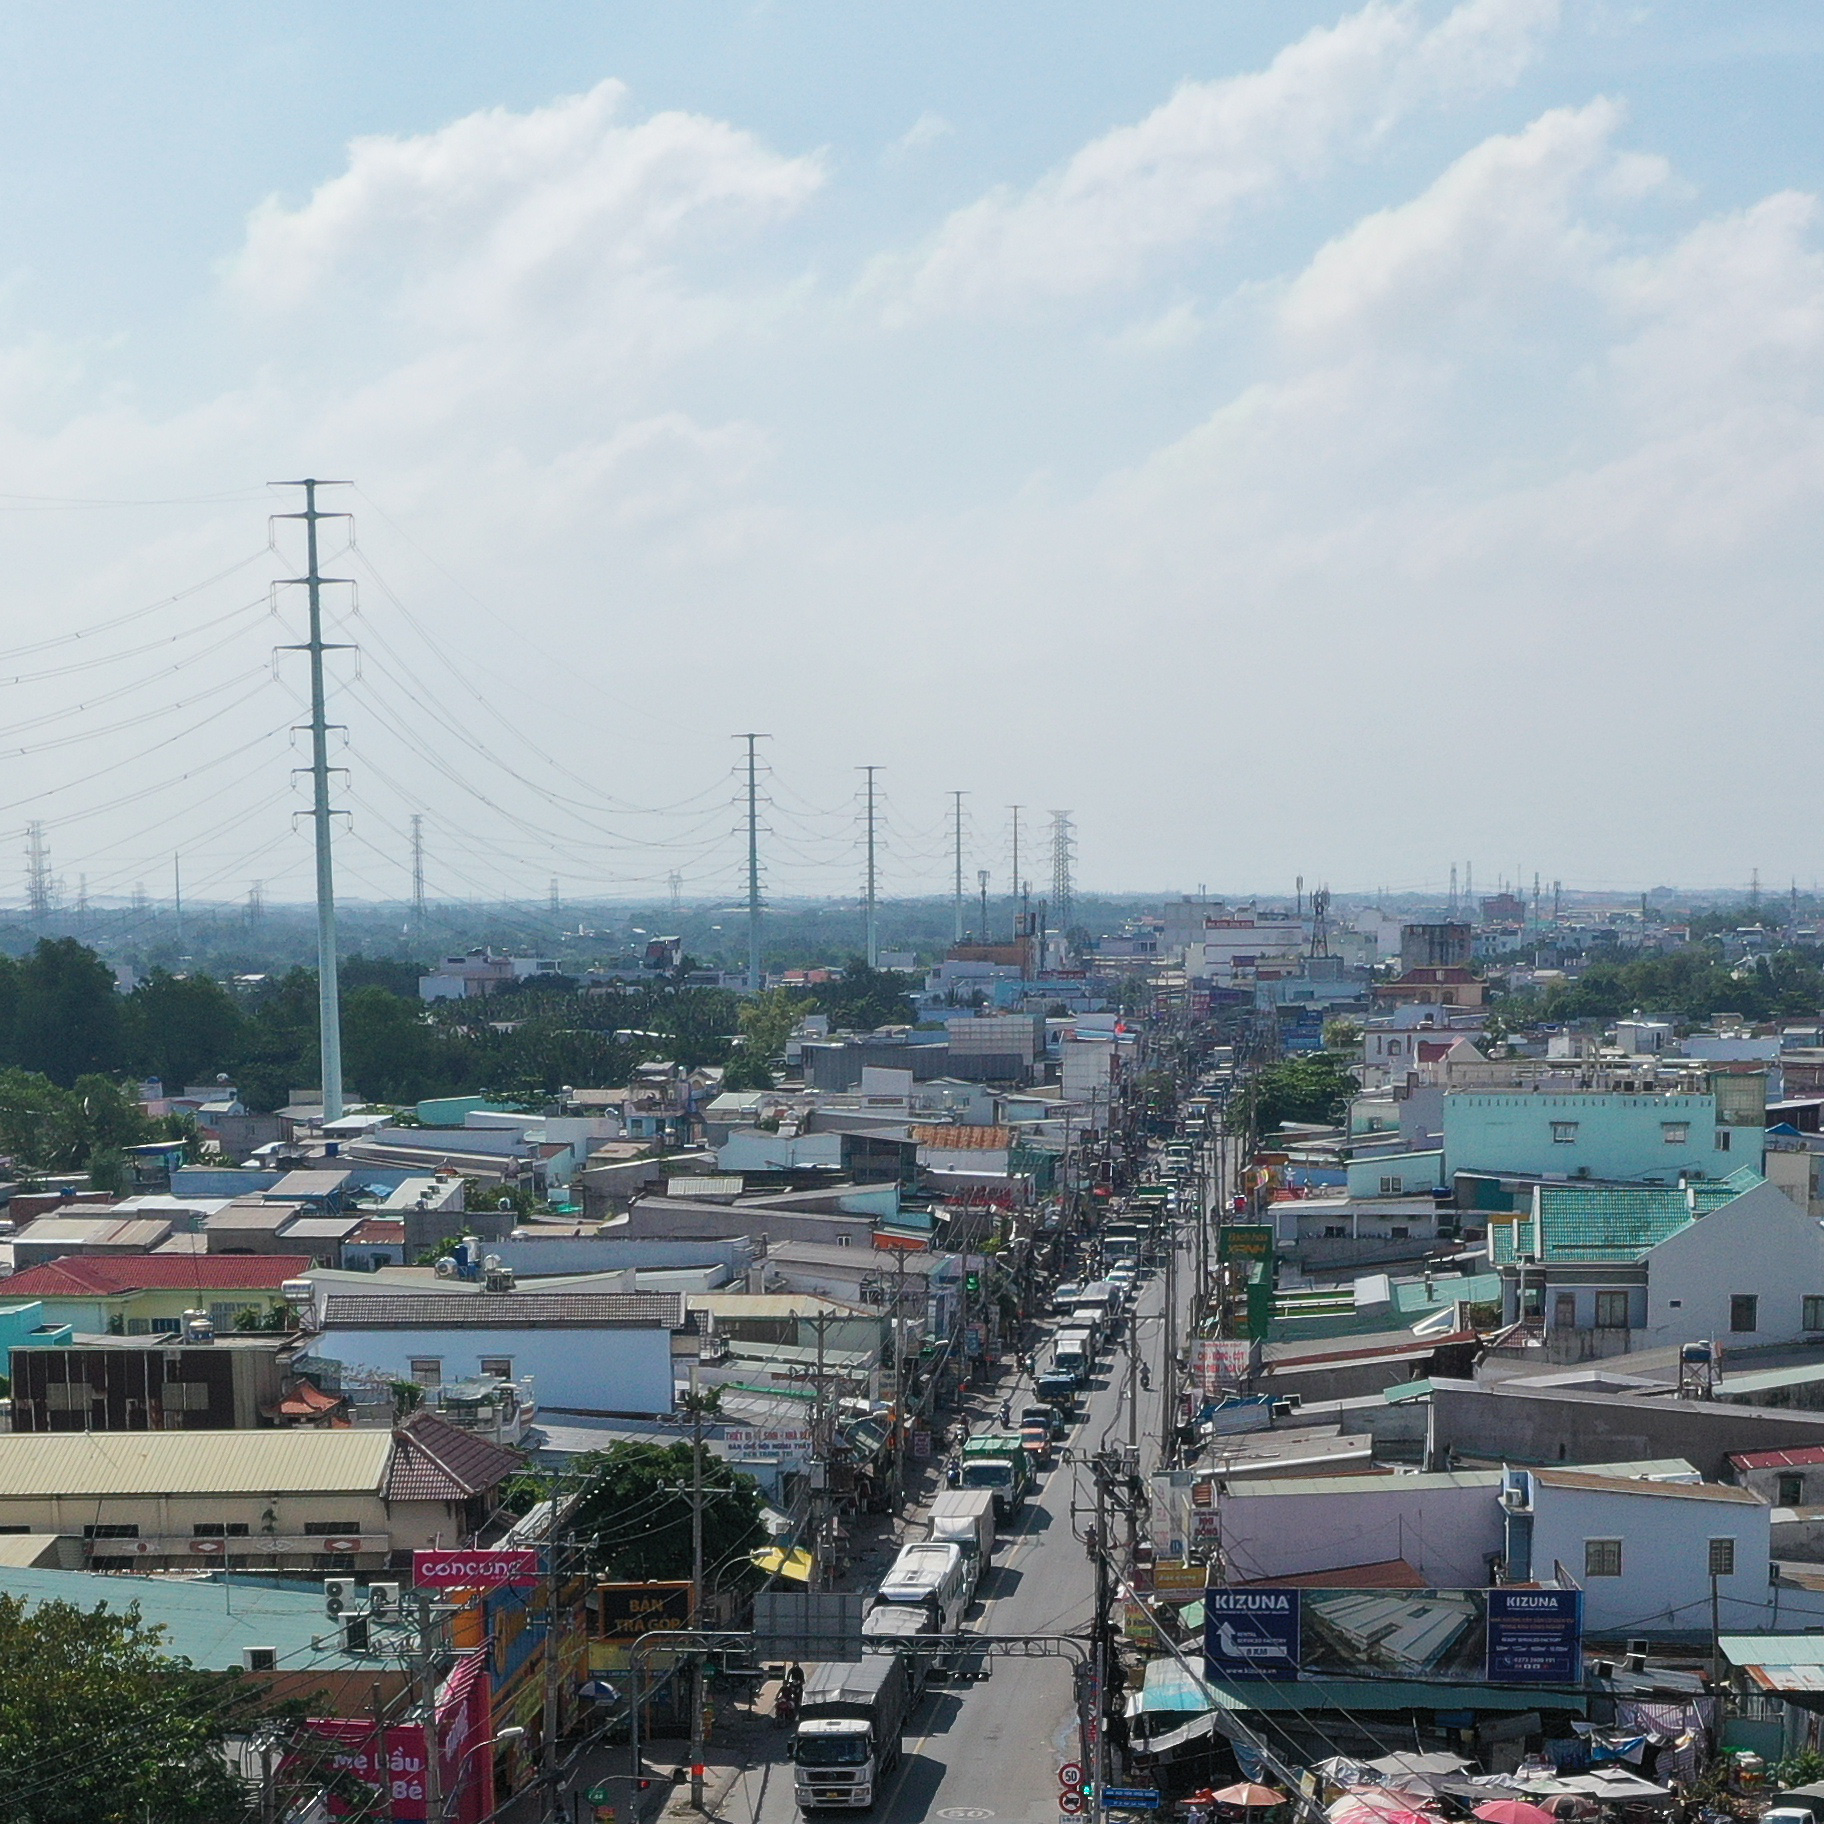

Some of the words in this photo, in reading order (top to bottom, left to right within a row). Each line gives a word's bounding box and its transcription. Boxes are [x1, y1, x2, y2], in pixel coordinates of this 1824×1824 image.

[1215, 1595, 1290, 1609] KIZUNA
[1506, 1597, 1558, 1607] KIZUNA
[1065, 1770, 1077, 1782] 50
